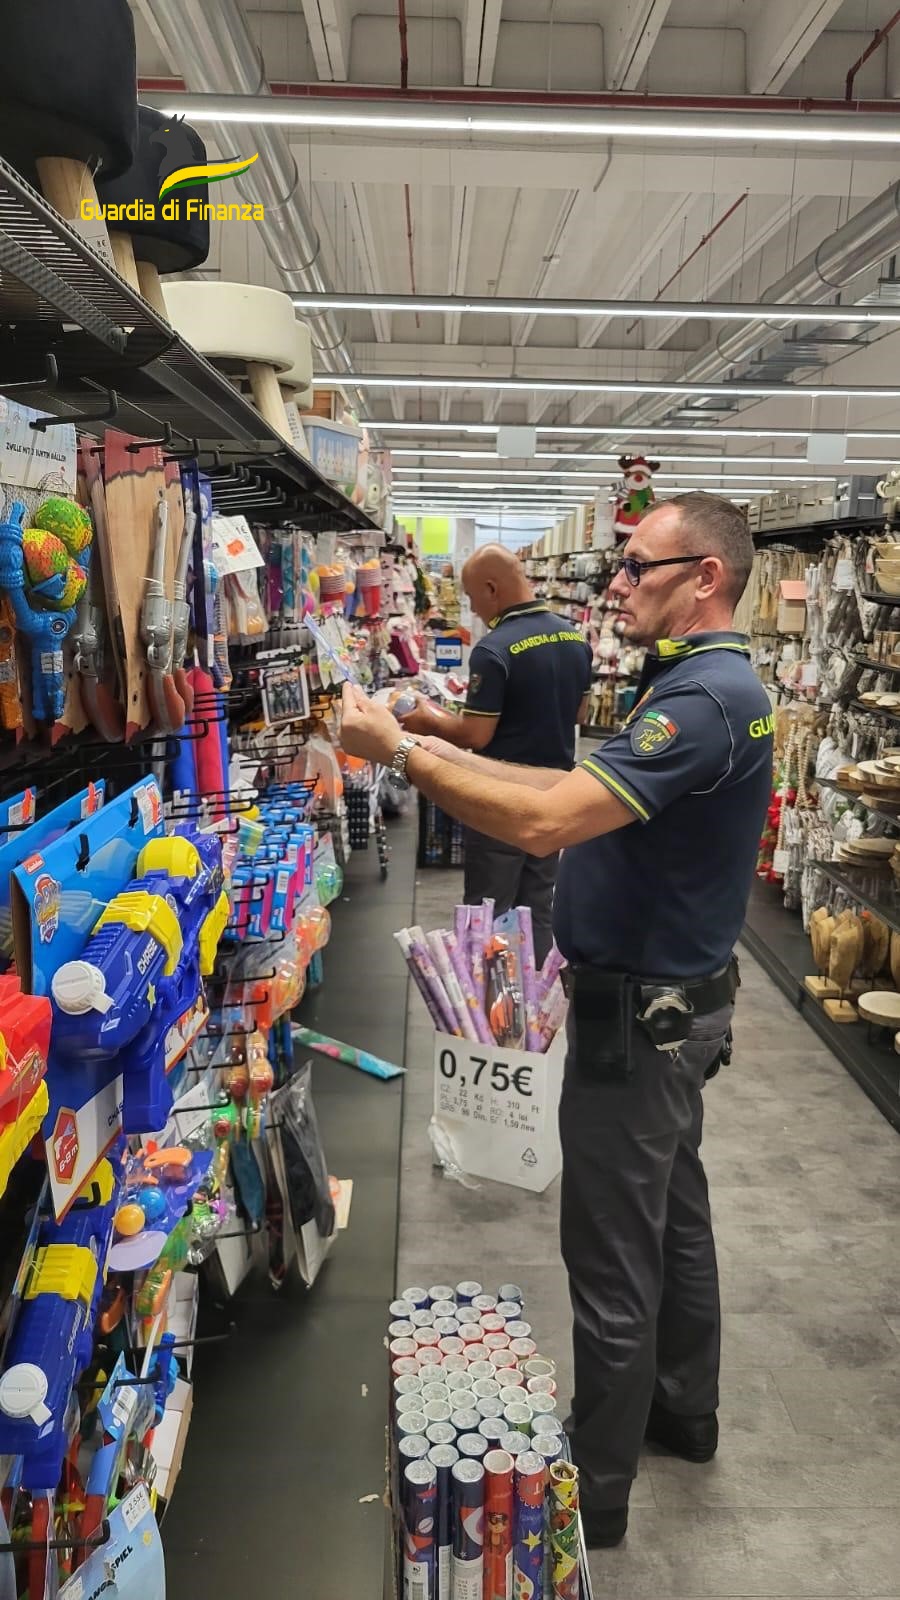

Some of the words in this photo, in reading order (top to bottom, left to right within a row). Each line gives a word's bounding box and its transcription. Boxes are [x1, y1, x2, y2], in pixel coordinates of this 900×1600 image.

[510, 633, 549, 654] GUARDIA
[549, 633, 559, 643] di
[440, 1049, 533, 1097] 0,75€
